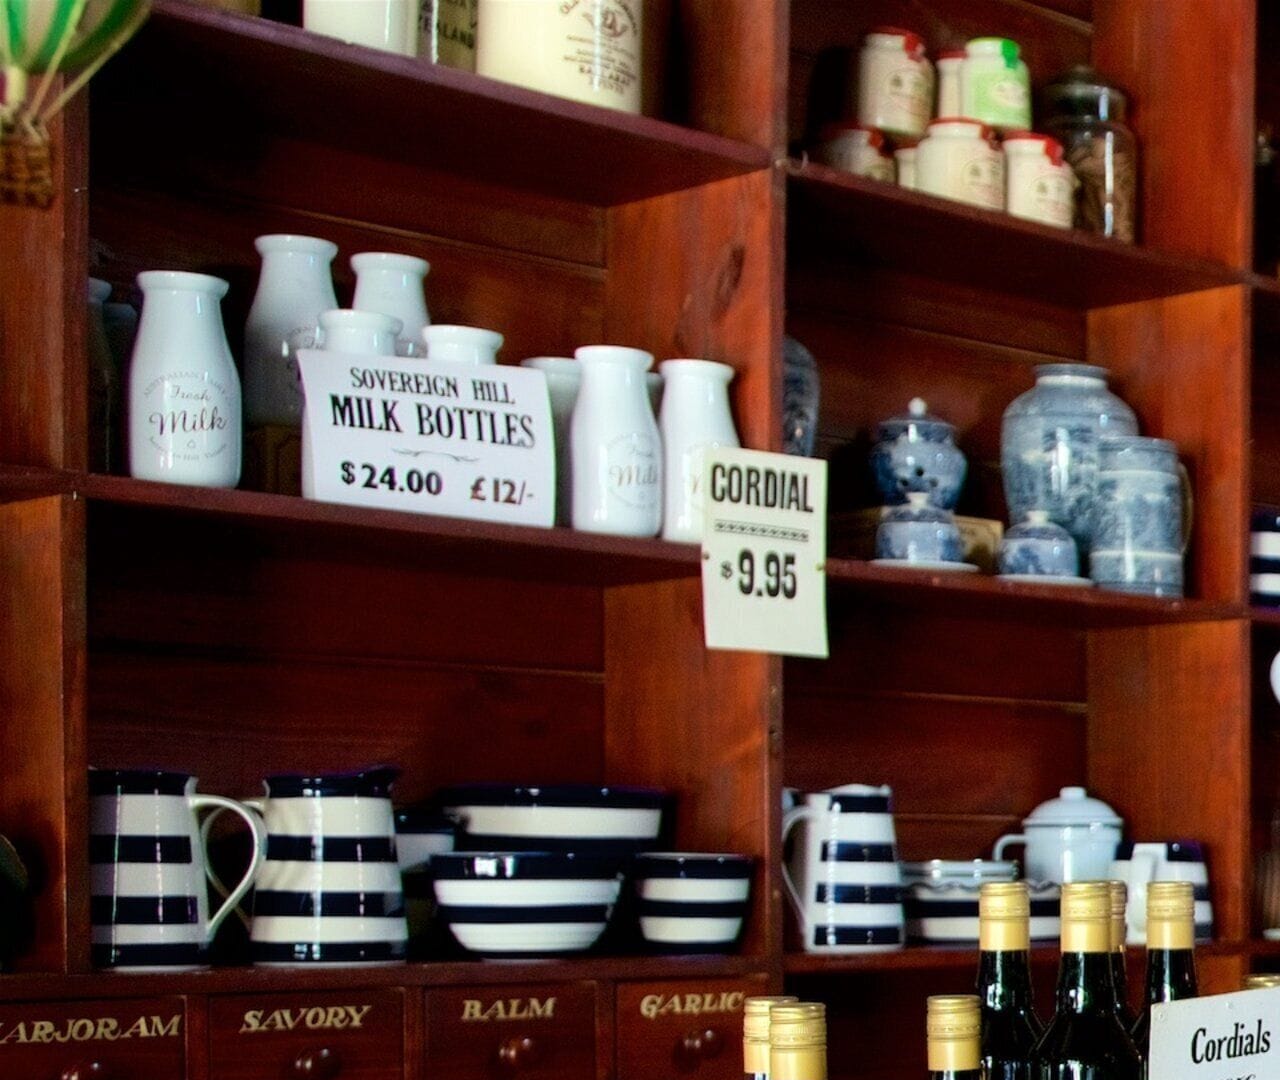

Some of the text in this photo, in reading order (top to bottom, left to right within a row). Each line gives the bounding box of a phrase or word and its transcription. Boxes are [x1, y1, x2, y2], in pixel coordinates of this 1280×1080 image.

[350, 367, 515, 405] SOVEREIGN HILL
[149, 406, 229, 436] Milk
[329, 393, 535, 449] MILK BOTTLES
[340, 461, 443, 495] $24.00
[711, 463, 814, 513] CORDIAL
[721, 549, 797, 599] $9.95
[239, 1005, 371, 1034] SAVORY
[461, 997, 556, 1021] BALM
[640, 992, 746, 1019] GARLIC
[0, 1014, 182, 1045] ARJORAM
[1190, 1019, 1272, 1067] Cordials
